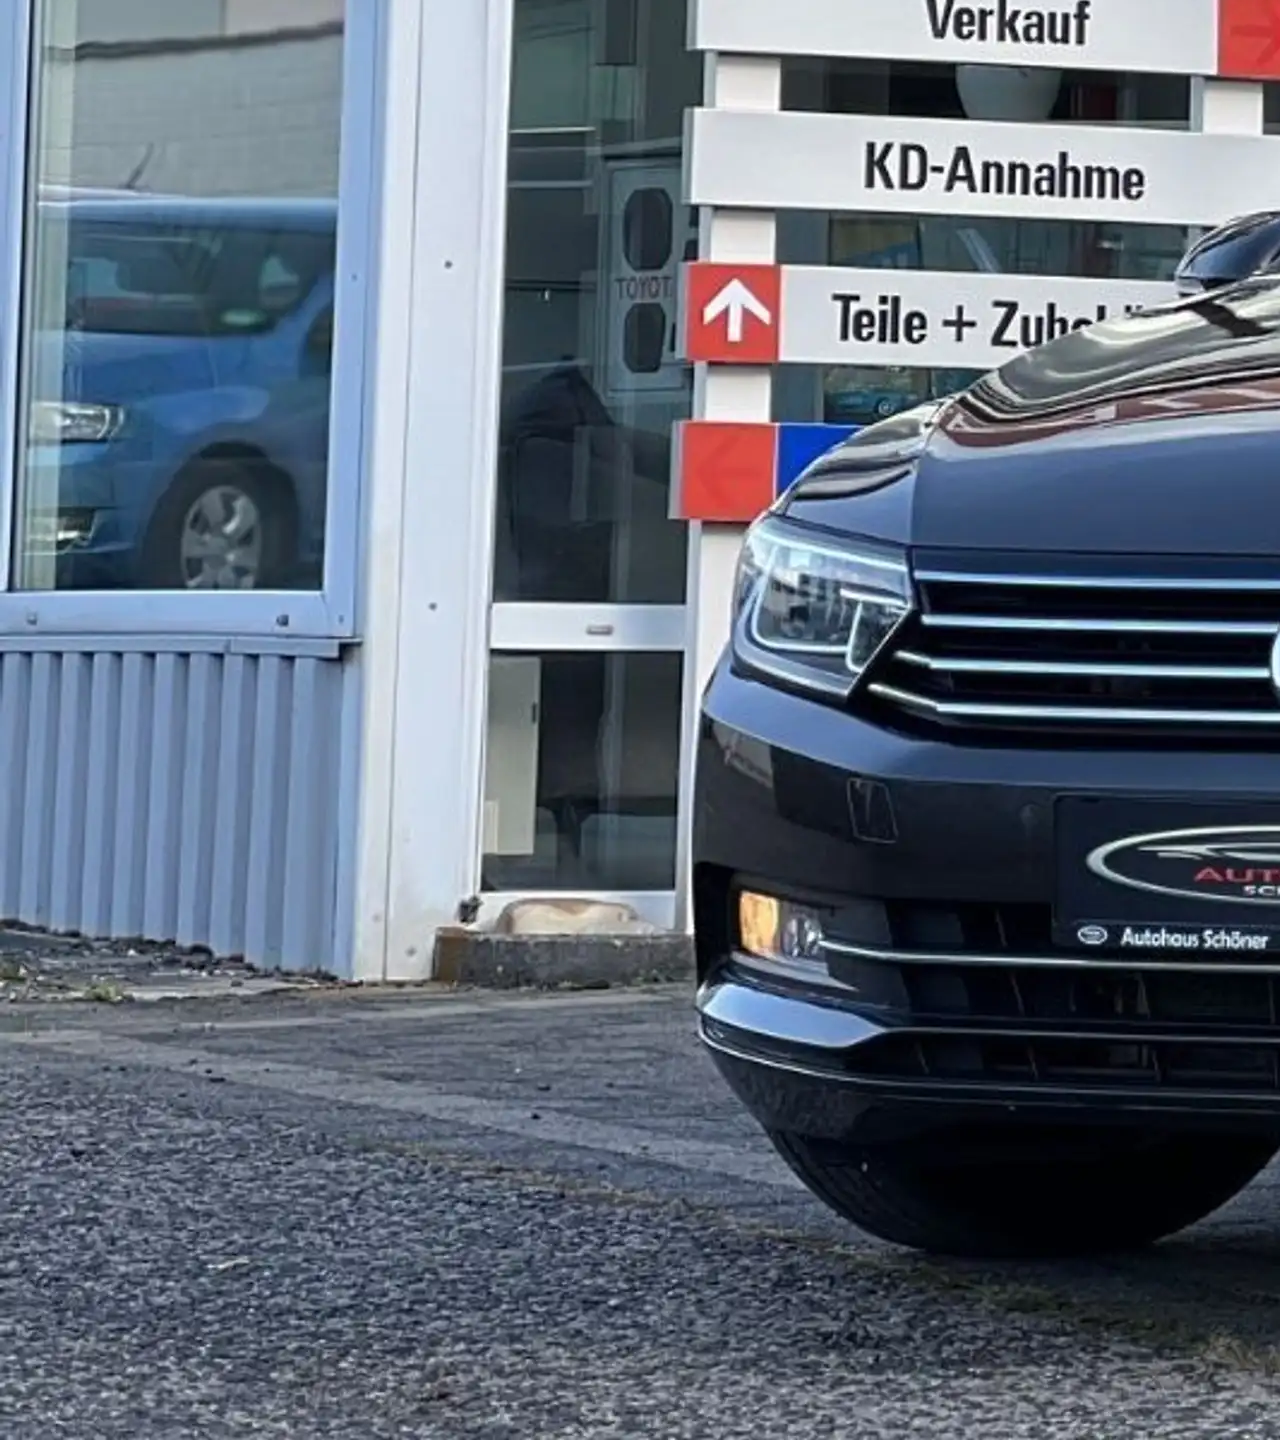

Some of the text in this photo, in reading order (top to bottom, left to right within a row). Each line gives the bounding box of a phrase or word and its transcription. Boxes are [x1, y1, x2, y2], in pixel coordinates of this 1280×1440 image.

[863, 142, 1145, 200] KD-Annahme
[614, 276, 673, 300] TOYOT
[832, 293, 928, 344] Teile
[1121, 926, 1199, 948] Autohaus
[1203, 929, 1268, 950] Schöner
